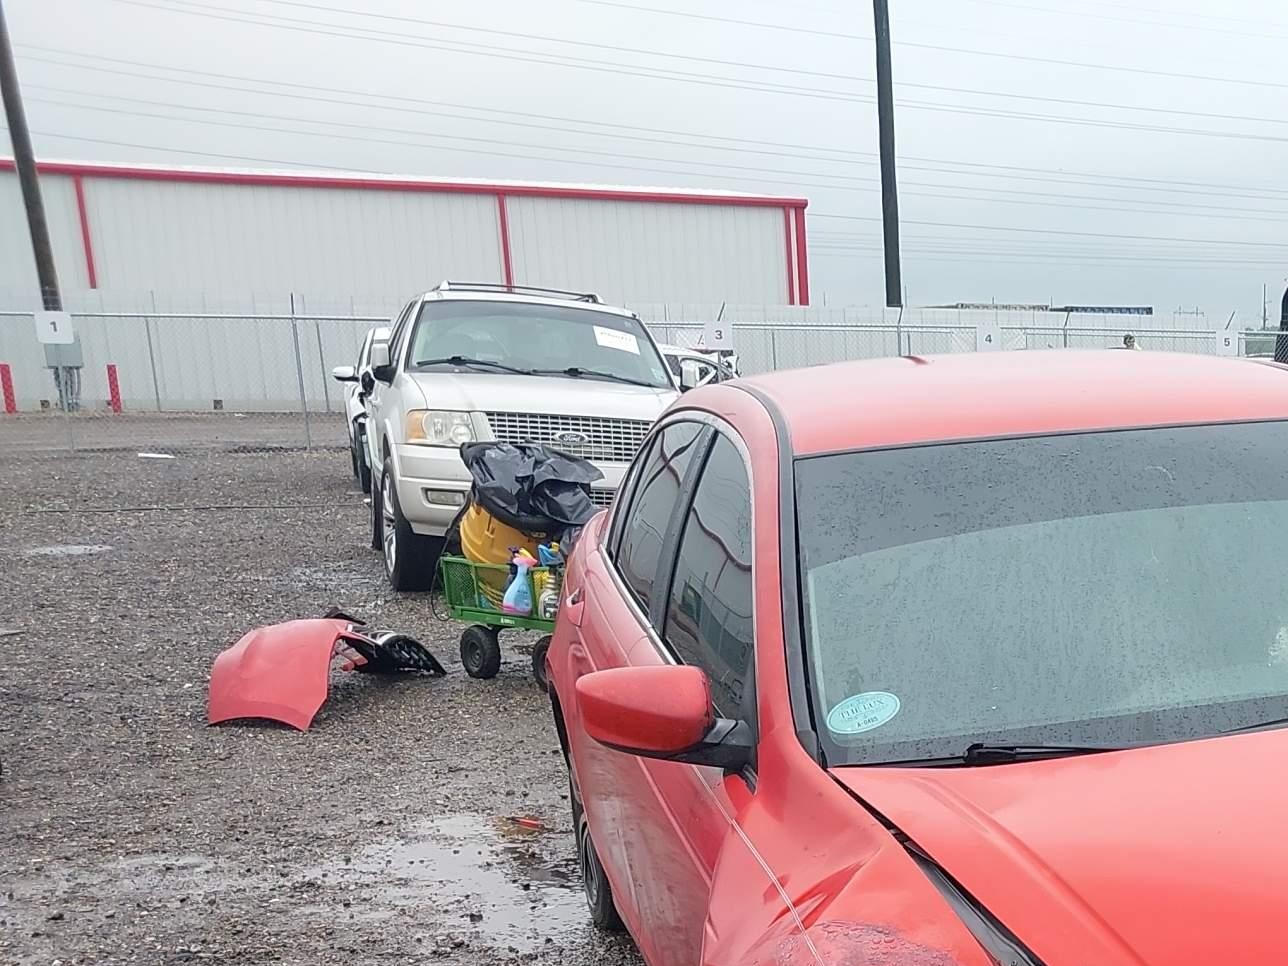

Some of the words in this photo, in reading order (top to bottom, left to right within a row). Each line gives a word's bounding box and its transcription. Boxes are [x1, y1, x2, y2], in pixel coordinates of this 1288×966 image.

[49, 320, 58, 333] 1
[714, 329, 724, 341] 3
[984, 333, 993, 344] 4
[1223, 337, 1232, 347] 5
